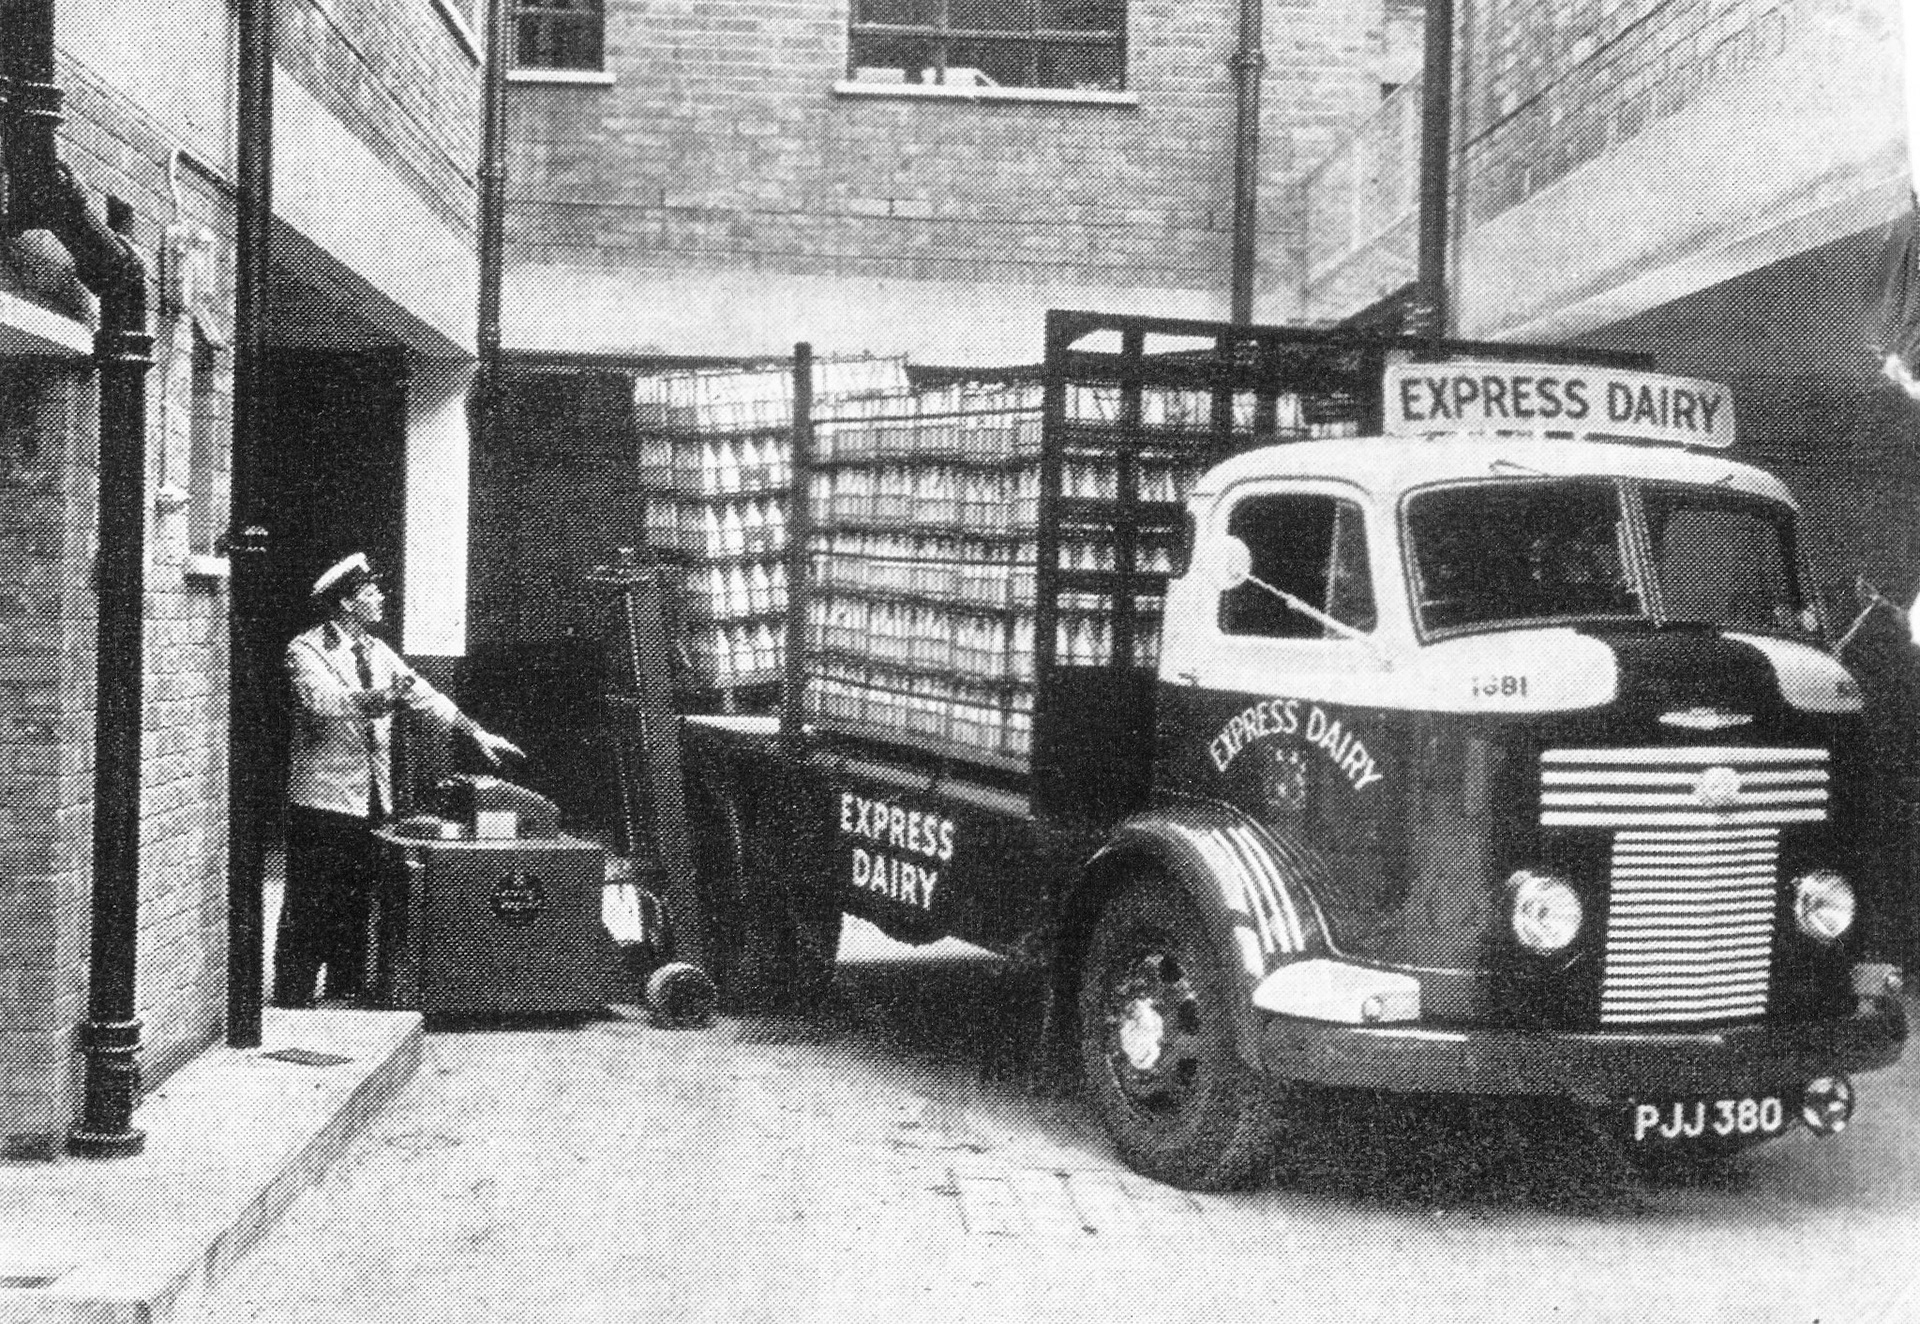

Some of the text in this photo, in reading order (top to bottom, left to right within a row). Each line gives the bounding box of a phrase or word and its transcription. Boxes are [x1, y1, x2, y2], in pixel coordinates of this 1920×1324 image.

[1401, 375, 1722, 434] EXPRESS DAIRY
[1209, 699, 1384, 790] EXPRESS DAIRY
[840, 792, 953, 861] EXPRESS
[852, 848, 938, 910] DAIRY
[1635, 1097, 1782, 1142] PJJ 380
